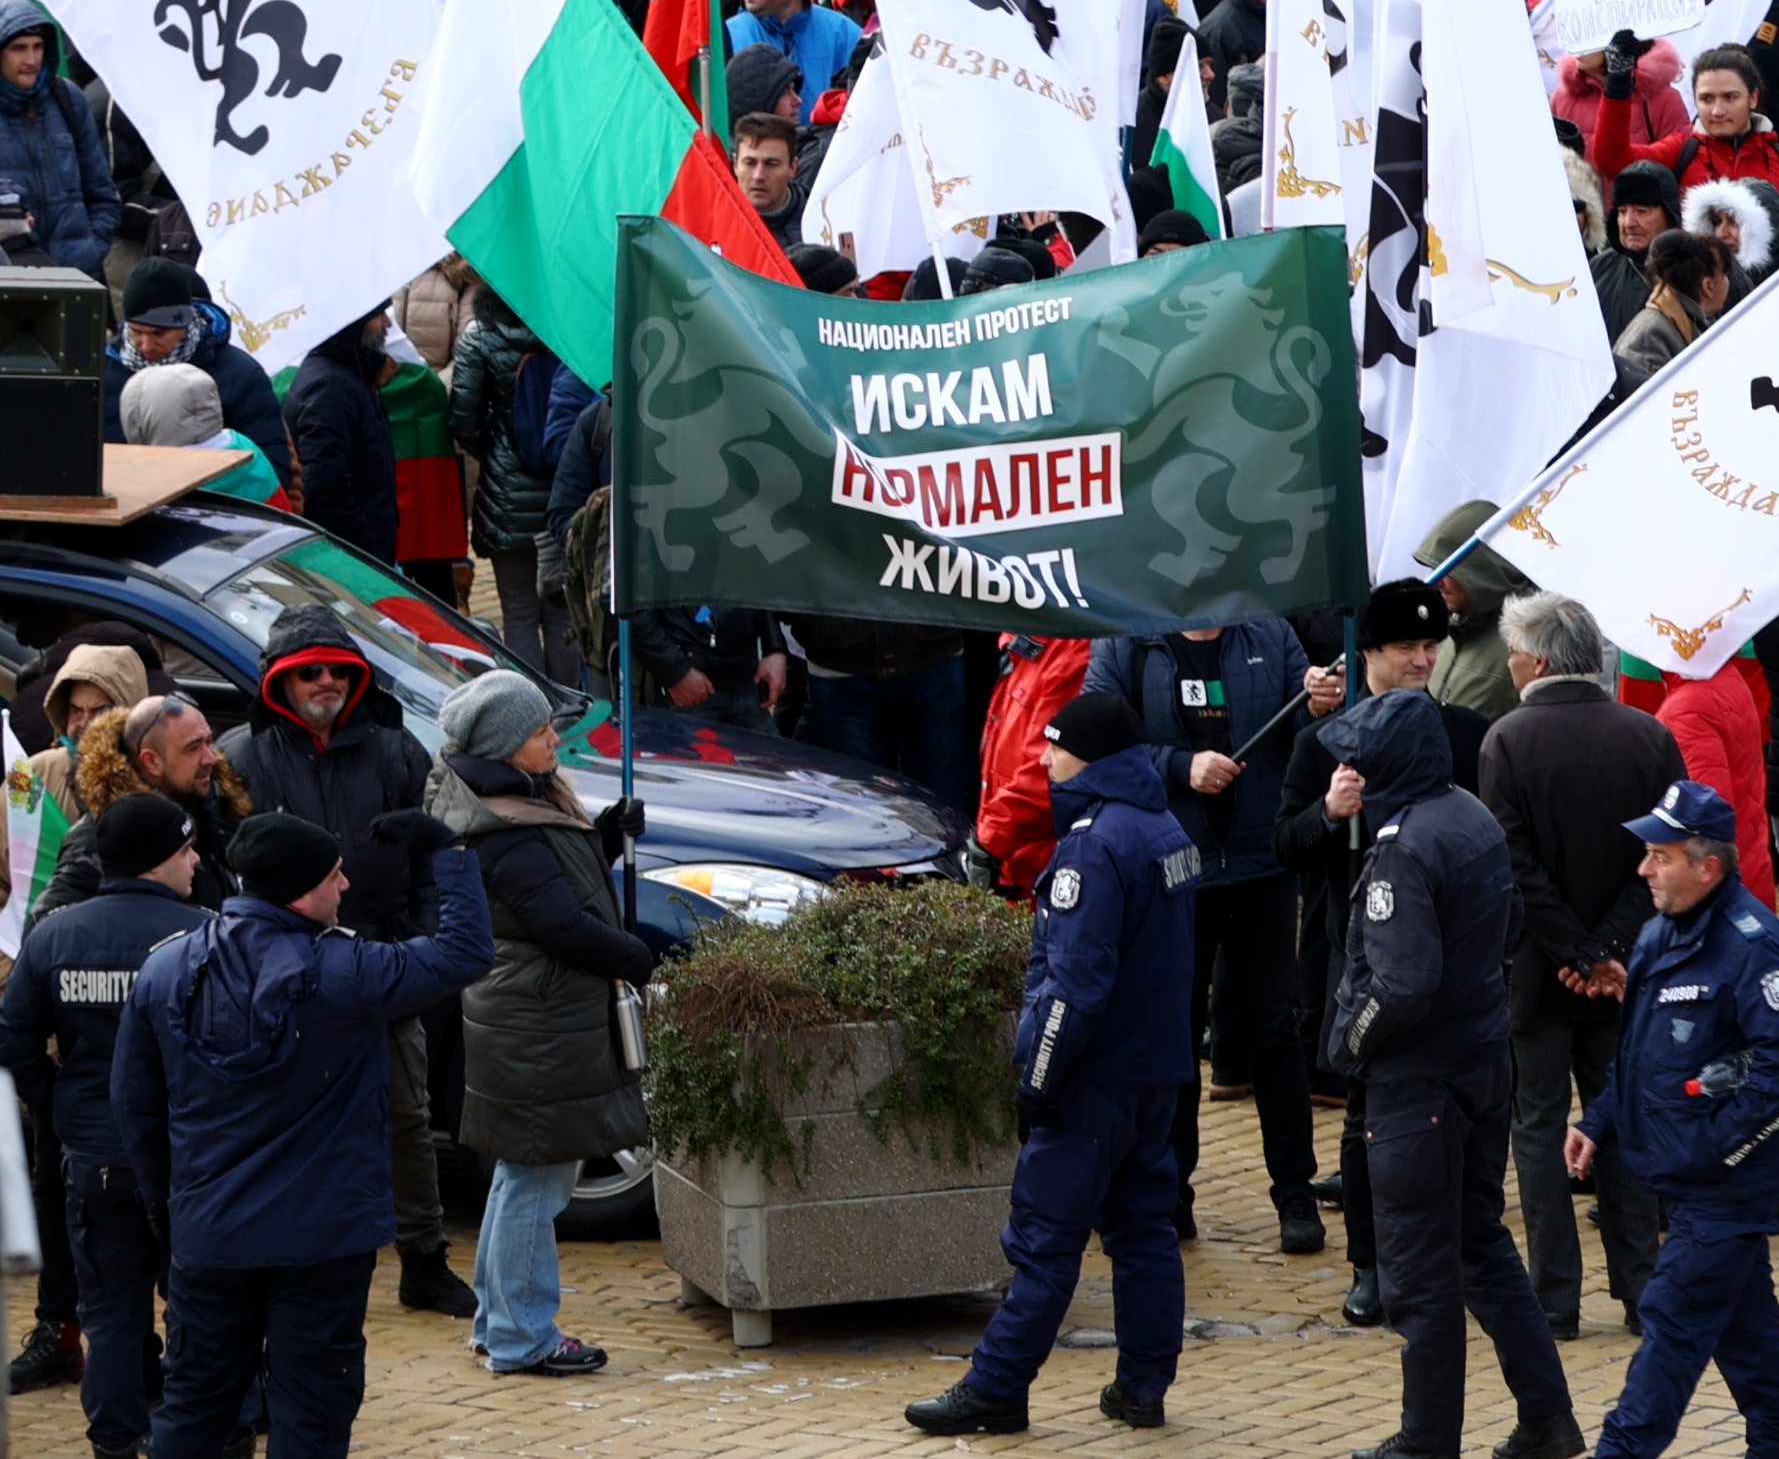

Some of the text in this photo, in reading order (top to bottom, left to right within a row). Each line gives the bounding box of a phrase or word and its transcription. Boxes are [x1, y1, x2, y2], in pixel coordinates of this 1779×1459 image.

[818, 296, 1073, 352] НАЦИОНАЛЕН ПРОТЕСТ
[850, 353, 1054, 435] ИСКАМ
[879, 533, 1090, 610] ЖИВОТ!
[60, 969, 130, 1004] SECURITY
[1029, 998, 1067, 1091] SECURITY POLICE
